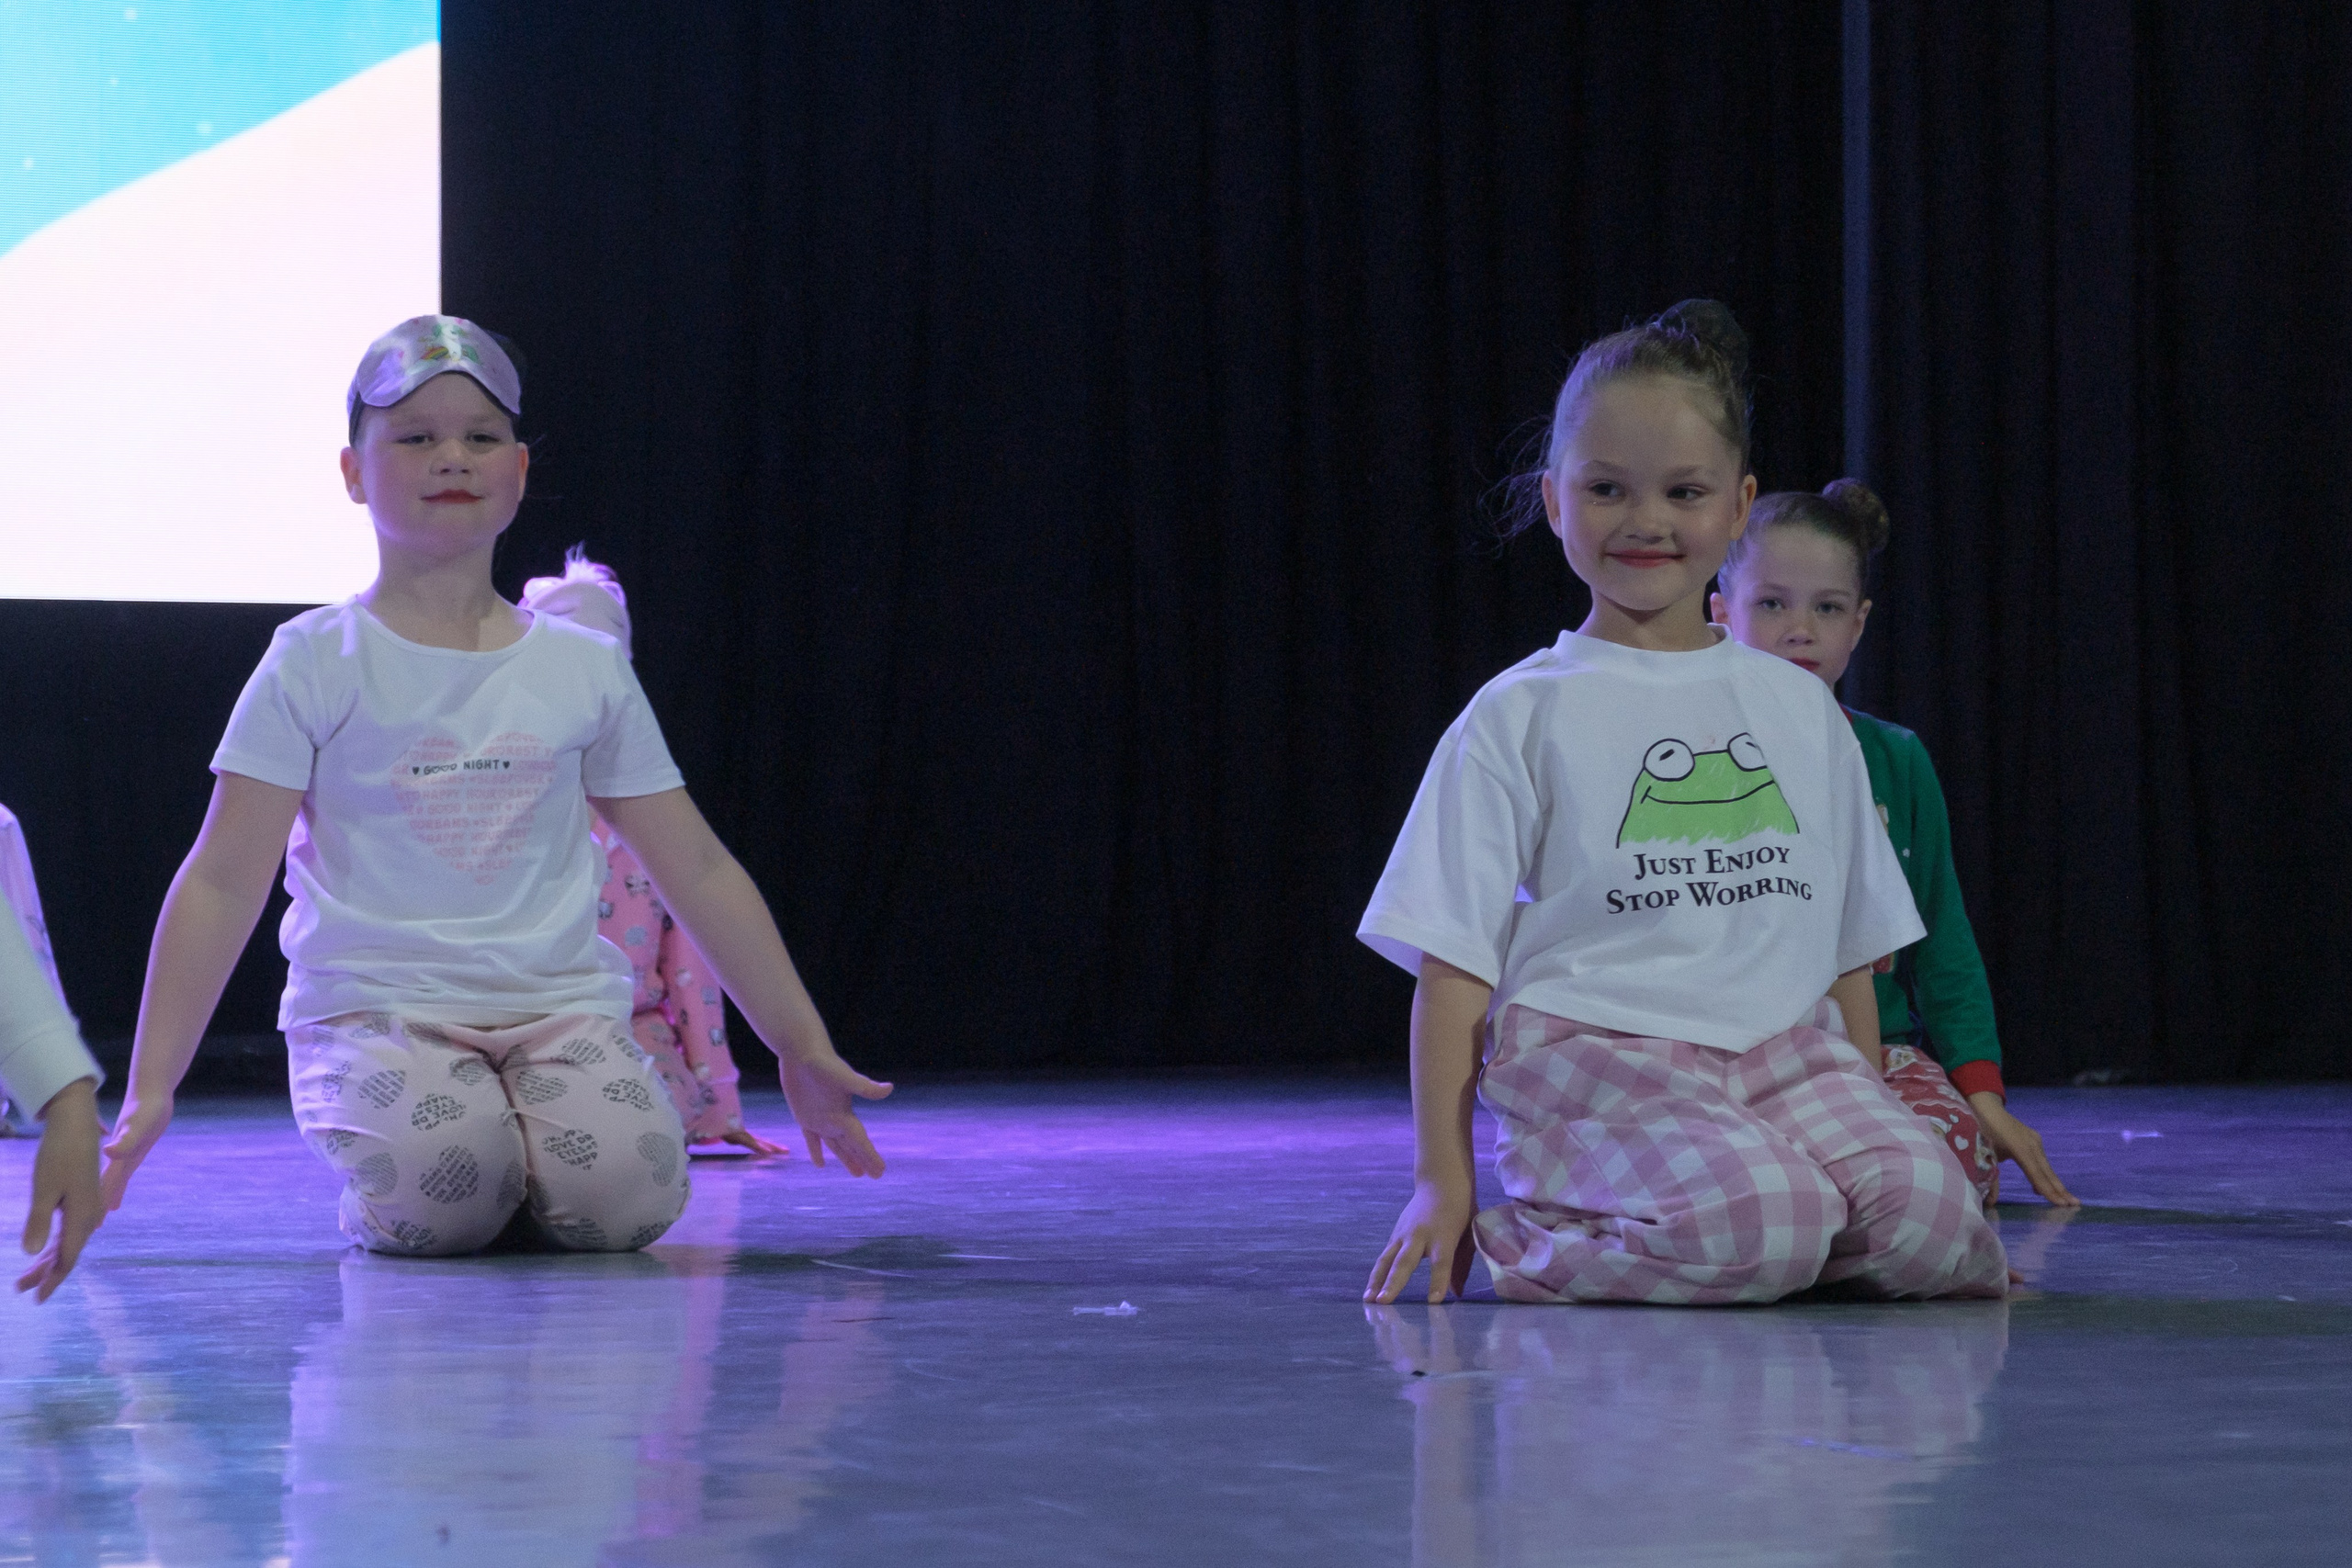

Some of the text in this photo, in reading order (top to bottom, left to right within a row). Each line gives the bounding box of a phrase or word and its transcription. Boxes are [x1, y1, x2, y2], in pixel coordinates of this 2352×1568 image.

[463, 759, 500, 770] NIGHT
[1633, 846, 1790, 881] JUST ENJOY
[1606, 876, 1813, 915] STOP WORRING
